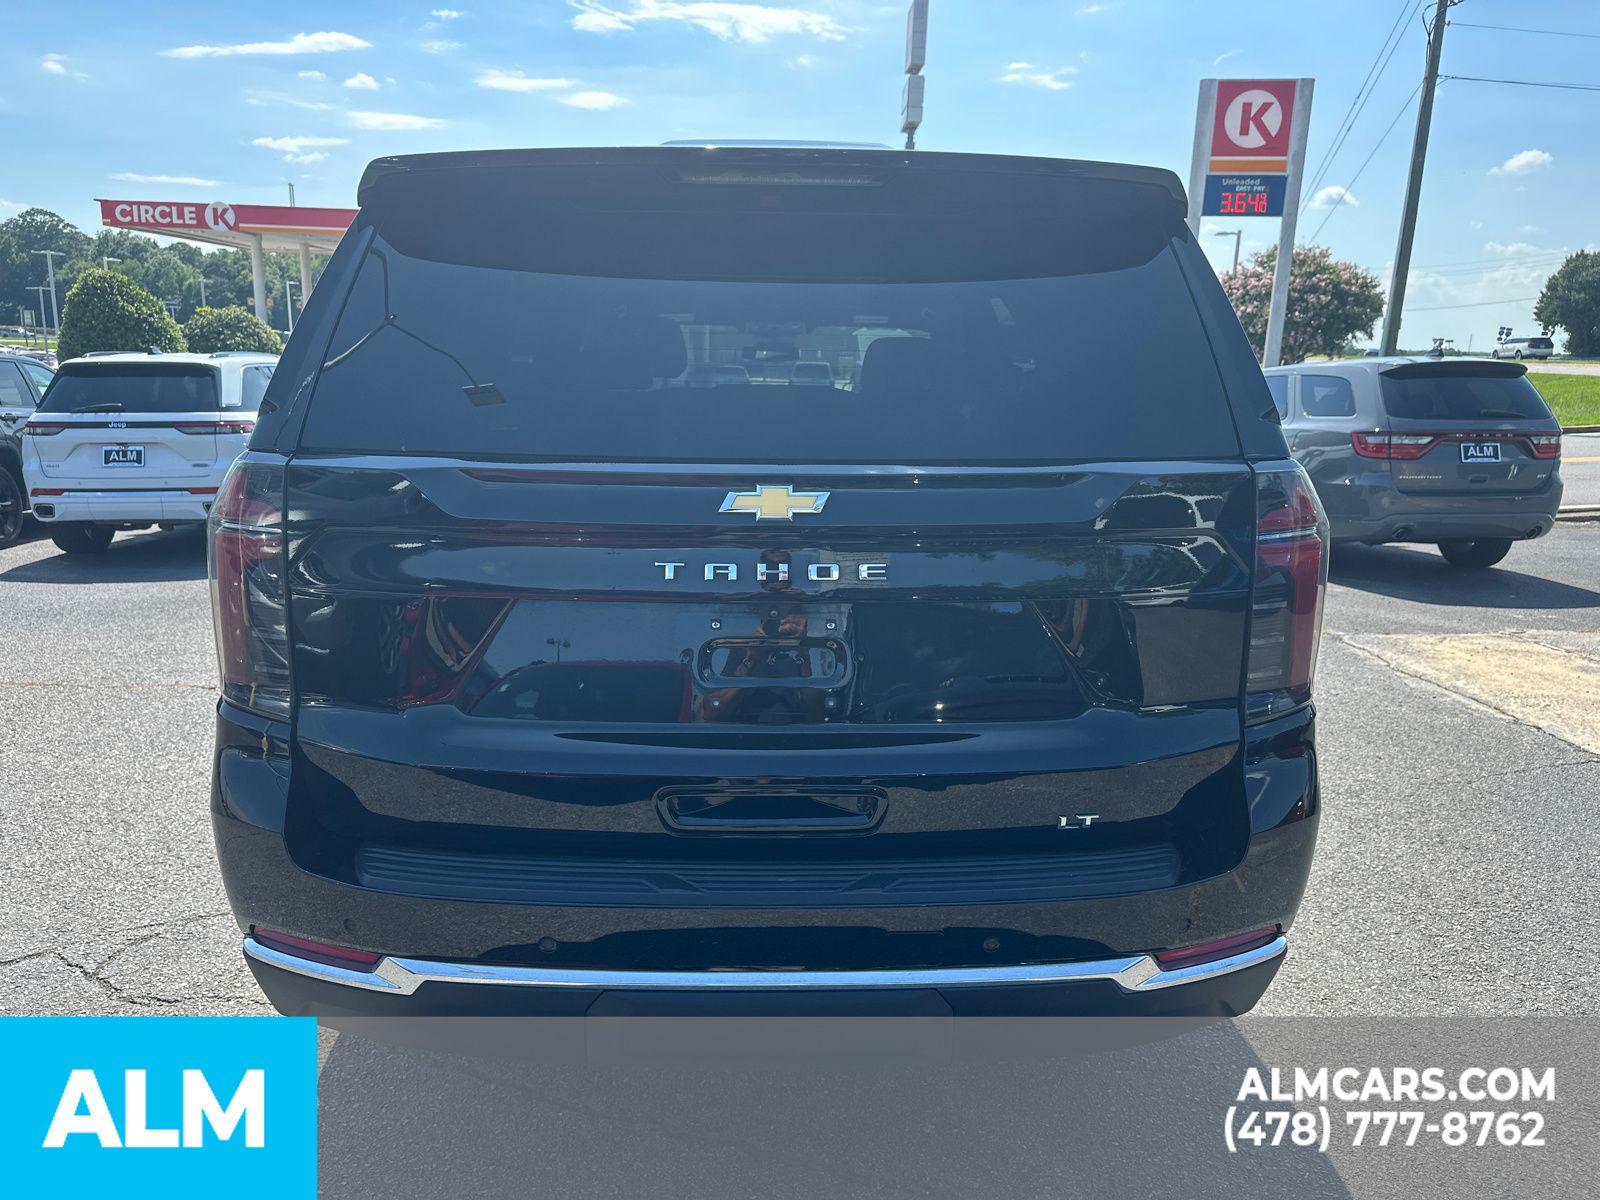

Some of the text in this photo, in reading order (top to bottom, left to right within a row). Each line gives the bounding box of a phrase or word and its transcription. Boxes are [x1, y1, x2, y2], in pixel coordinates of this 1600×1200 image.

[1222, 178, 1260, 186] Unleaded
[114, 204, 234, 231] CIRCLE K
[108, 421, 127, 429] Jeep
[109, 450, 137, 461] ALM
[1467, 446, 1494, 457] ALM
[655, 562, 888, 581] TAHOE
[1057, 814, 1099, 830] LT
